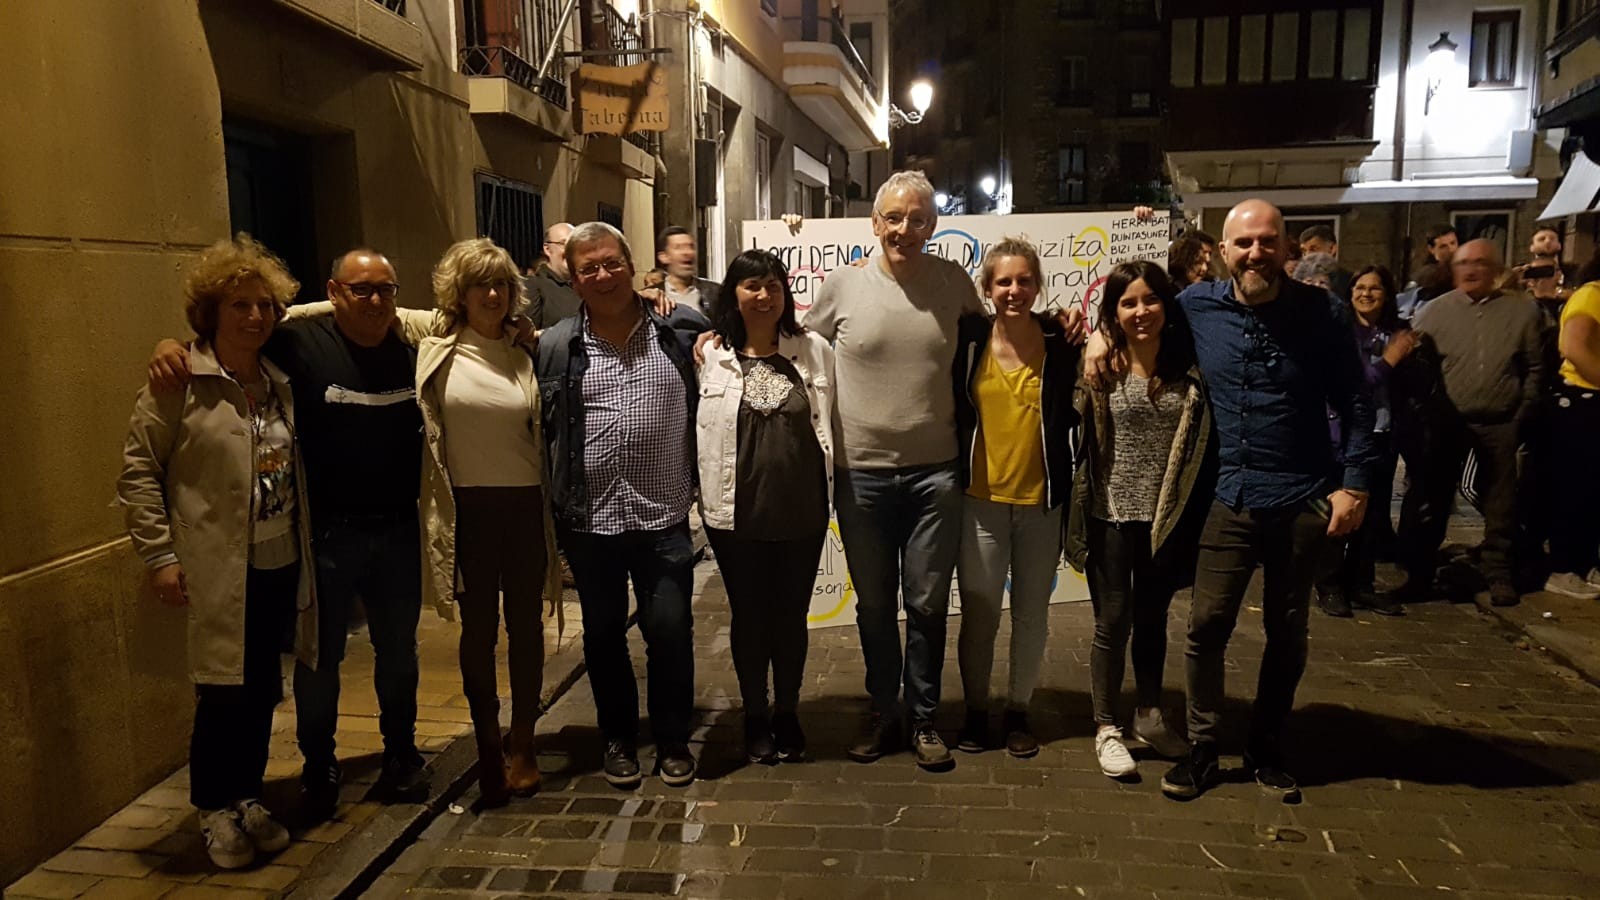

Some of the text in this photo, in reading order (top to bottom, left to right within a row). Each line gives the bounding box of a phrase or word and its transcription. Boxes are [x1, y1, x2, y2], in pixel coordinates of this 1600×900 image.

[580, 107, 664, 126] aberna
[1151, 215, 1170, 227] BAT
[1033, 232, 1107, 258] izitza
[1110, 242, 1157, 255] BIZI ETA
